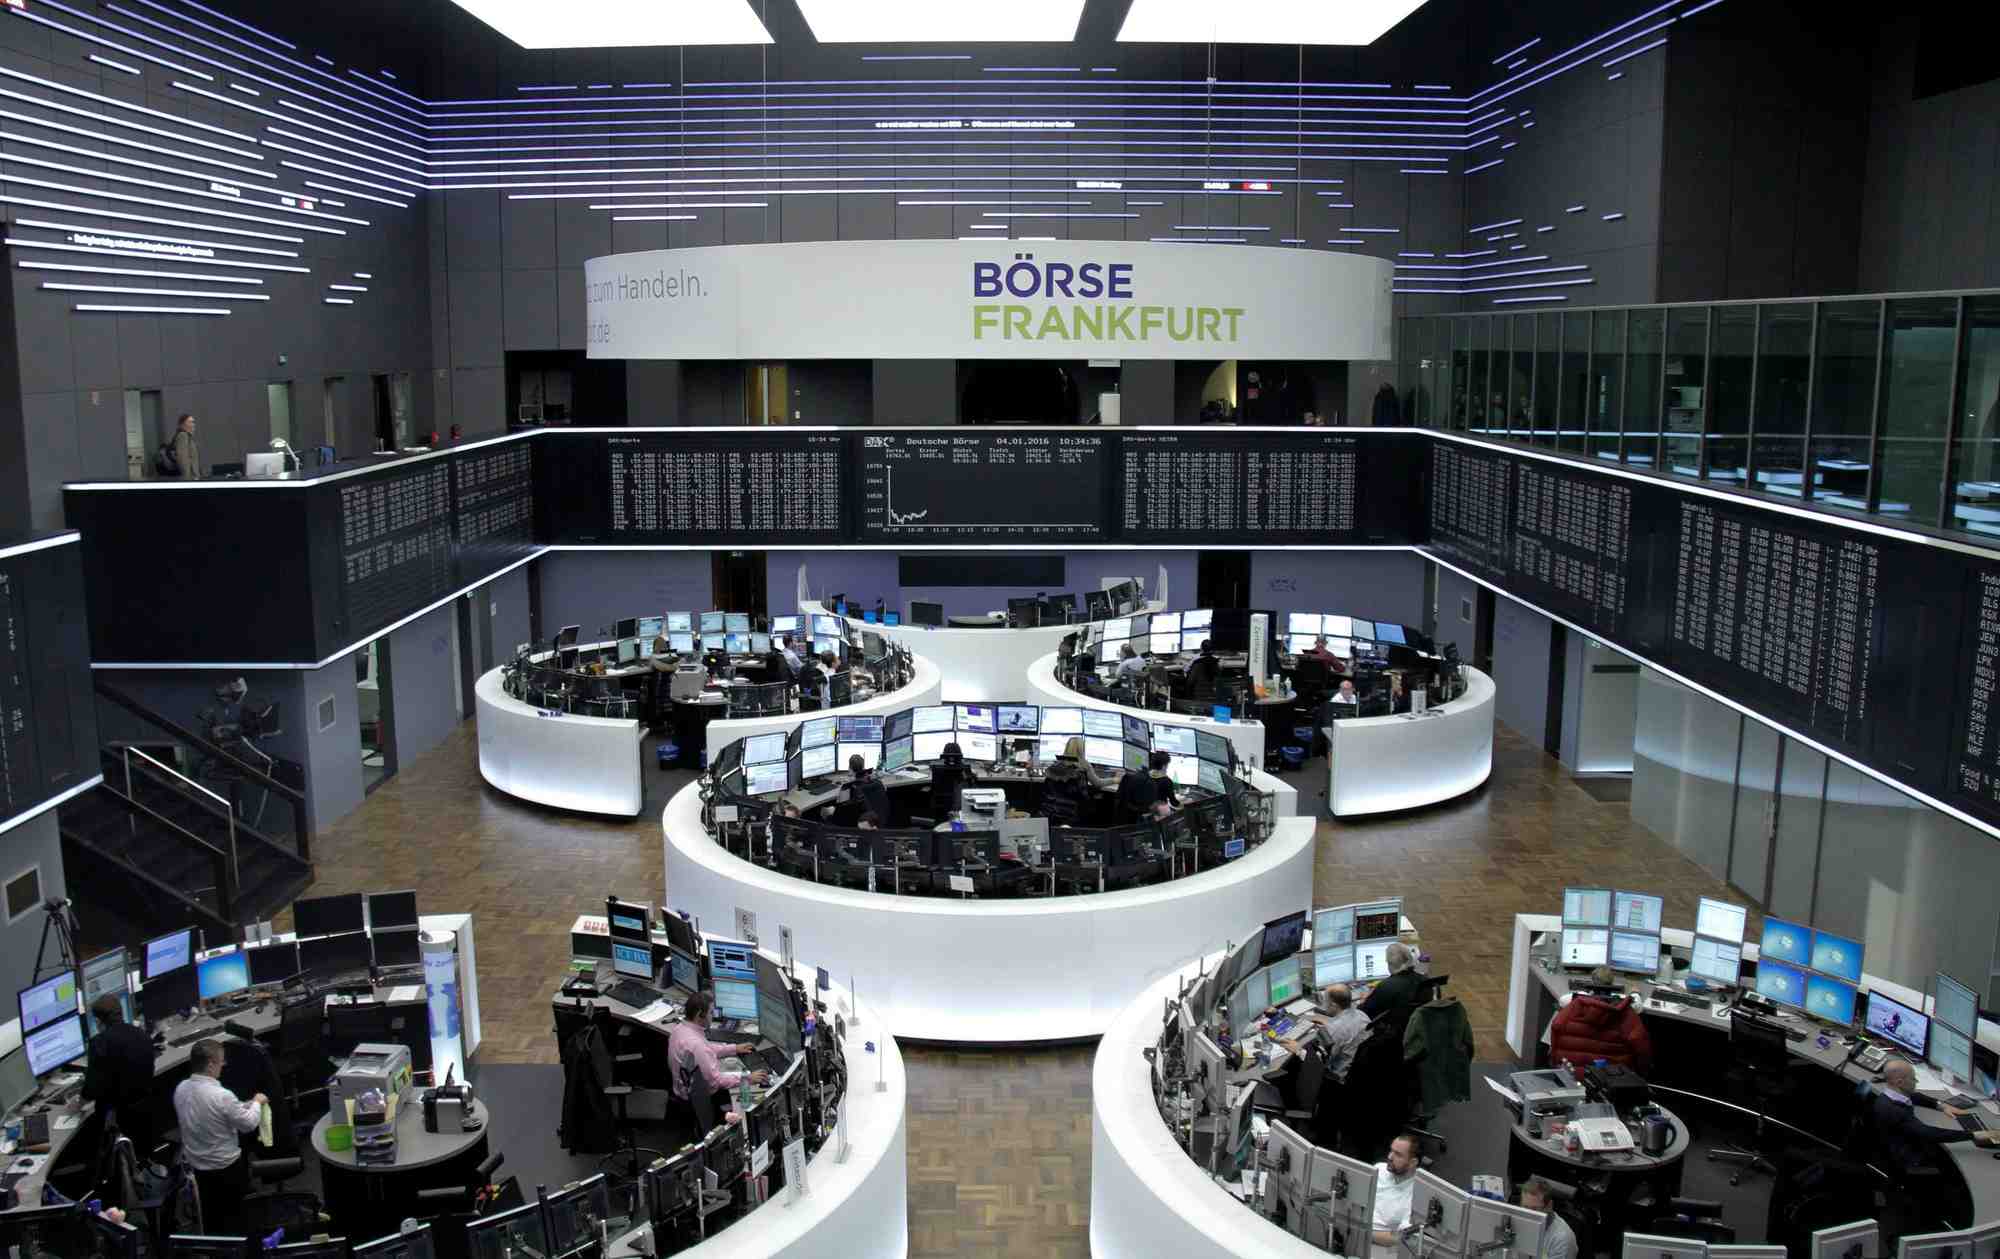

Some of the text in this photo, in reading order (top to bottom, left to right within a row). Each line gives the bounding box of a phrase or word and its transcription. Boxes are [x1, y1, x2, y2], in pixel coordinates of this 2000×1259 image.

[617, 268, 708, 301] Handeln.
[974, 253, 1134, 298] BÖRSE
[974, 304, 1245, 341] FRANKFURT
[906, 437, 949, 446] Deutsche
[953, 437, 980, 446] Börse
[996, 438, 1050, 446] 04.01.2016
[1059, 437, 1102, 446] 10:34:36
